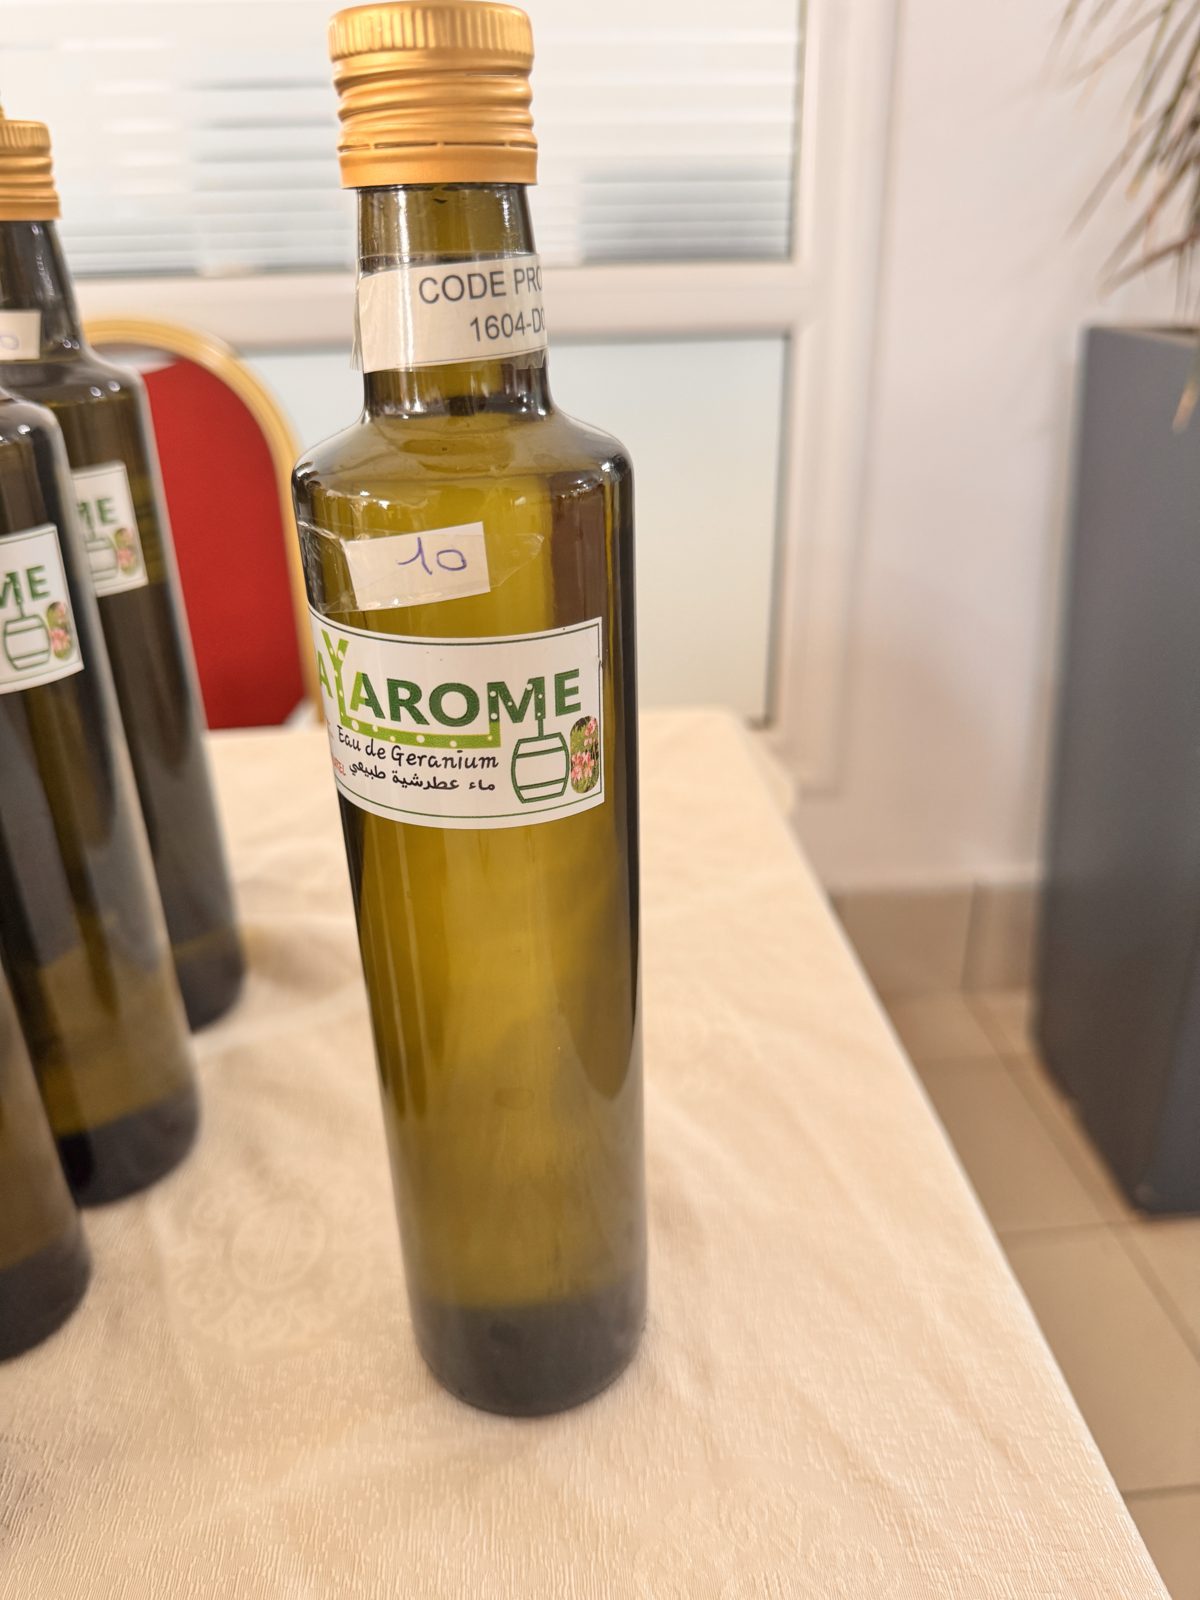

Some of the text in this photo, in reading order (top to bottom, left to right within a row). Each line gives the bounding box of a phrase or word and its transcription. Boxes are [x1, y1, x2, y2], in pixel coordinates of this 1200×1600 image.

[418, 270, 507, 304] CODE
[398, 536, 468, 576] 10
[336, 724, 499, 770] Eau de Geranium
[349, 761, 386, 780] طبيعي
[391, 769, 460, 791] عطرشية
[468, 779, 496, 791] ماء
